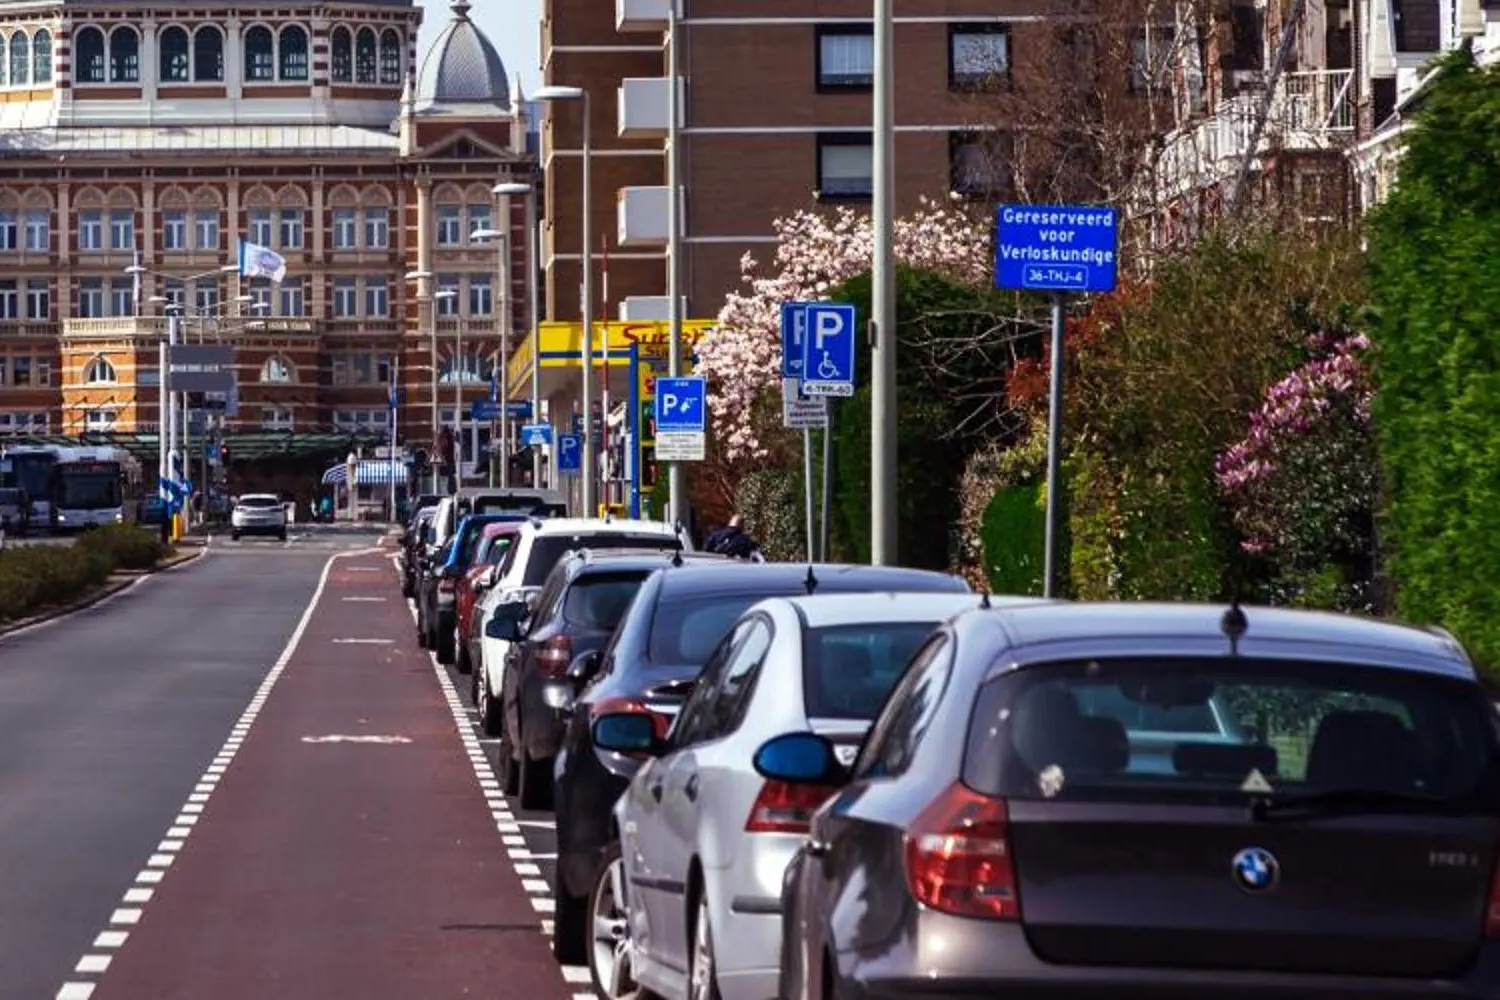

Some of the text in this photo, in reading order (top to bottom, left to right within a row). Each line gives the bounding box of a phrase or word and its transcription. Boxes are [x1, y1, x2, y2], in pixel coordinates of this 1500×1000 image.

[1003, 208, 1113, 227] Gereserveerd
[1039, 229, 1075, 241] voor
[1000, 244, 1113, 266] Verloskundige
[816, 311, 844, 349] P
[663, 394, 678, 417] P
[561, 437, 576, 455] P
